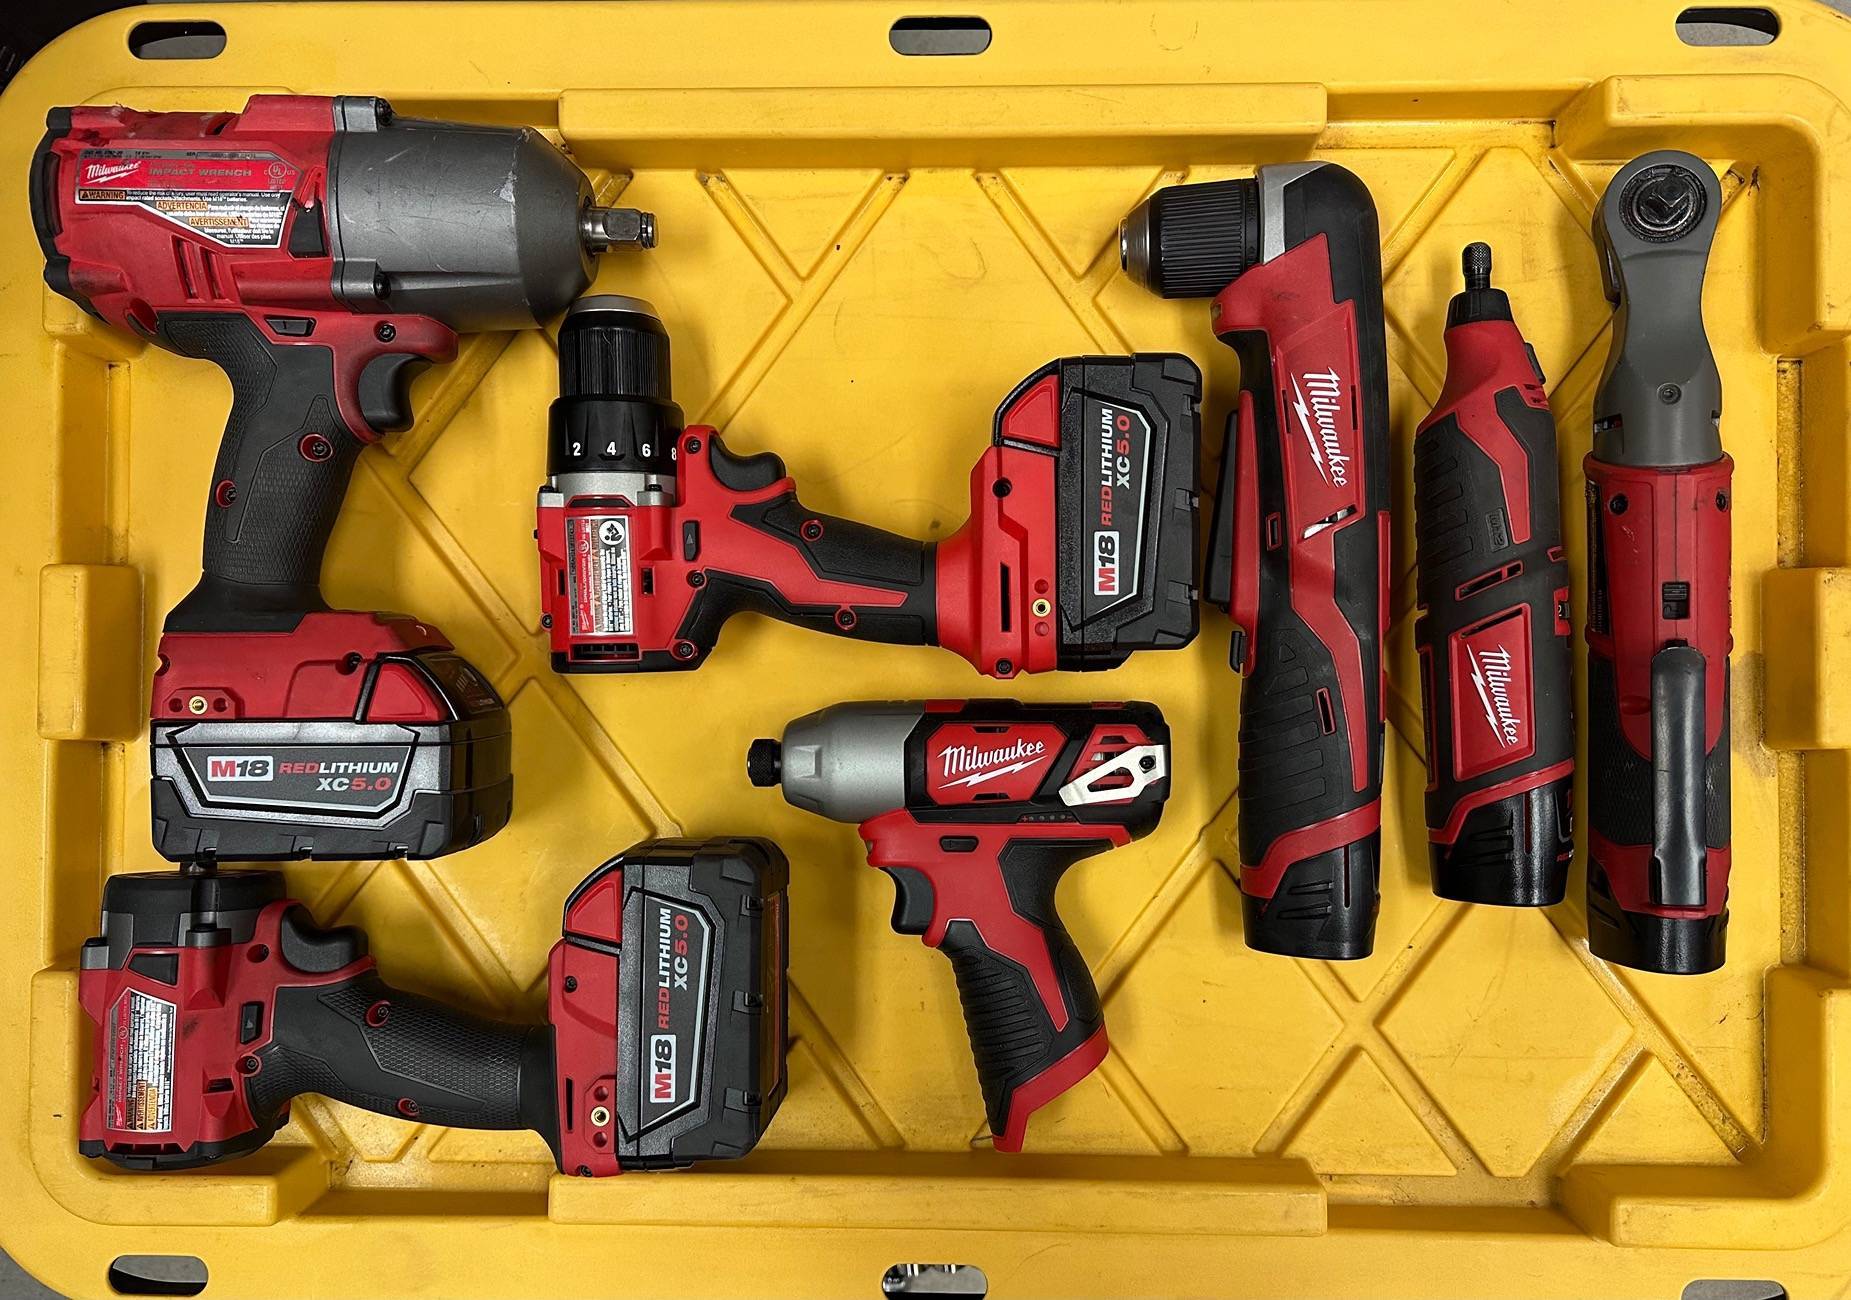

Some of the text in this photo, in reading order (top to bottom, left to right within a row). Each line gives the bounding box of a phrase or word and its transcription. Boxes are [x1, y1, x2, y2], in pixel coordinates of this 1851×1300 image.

[199, 168, 252, 176] WRENCH
[89, 191, 124, 200] WARNING
[157, 201, 207, 210] ADVERTENCIA
[1302, 366, 1350, 488] Milwaukee
[572, 441, 676, 461] 2 4 6 8
[1116, 414, 1132, 490] XC5.0
[1098, 408, 1116, 592] M18 REDLITHIUM
[1478, 643, 1520, 746] Milwaukee
[210, 760, 399, 778] M18 REDLITHIUM
[936, 738, 1046, 778] Milwaukee
[316, 776, 392, 792] XC5.0
[674, 914, 689, 992] XC5.0
[654, 907, 672, 1099] M18 REDLITHIUM
